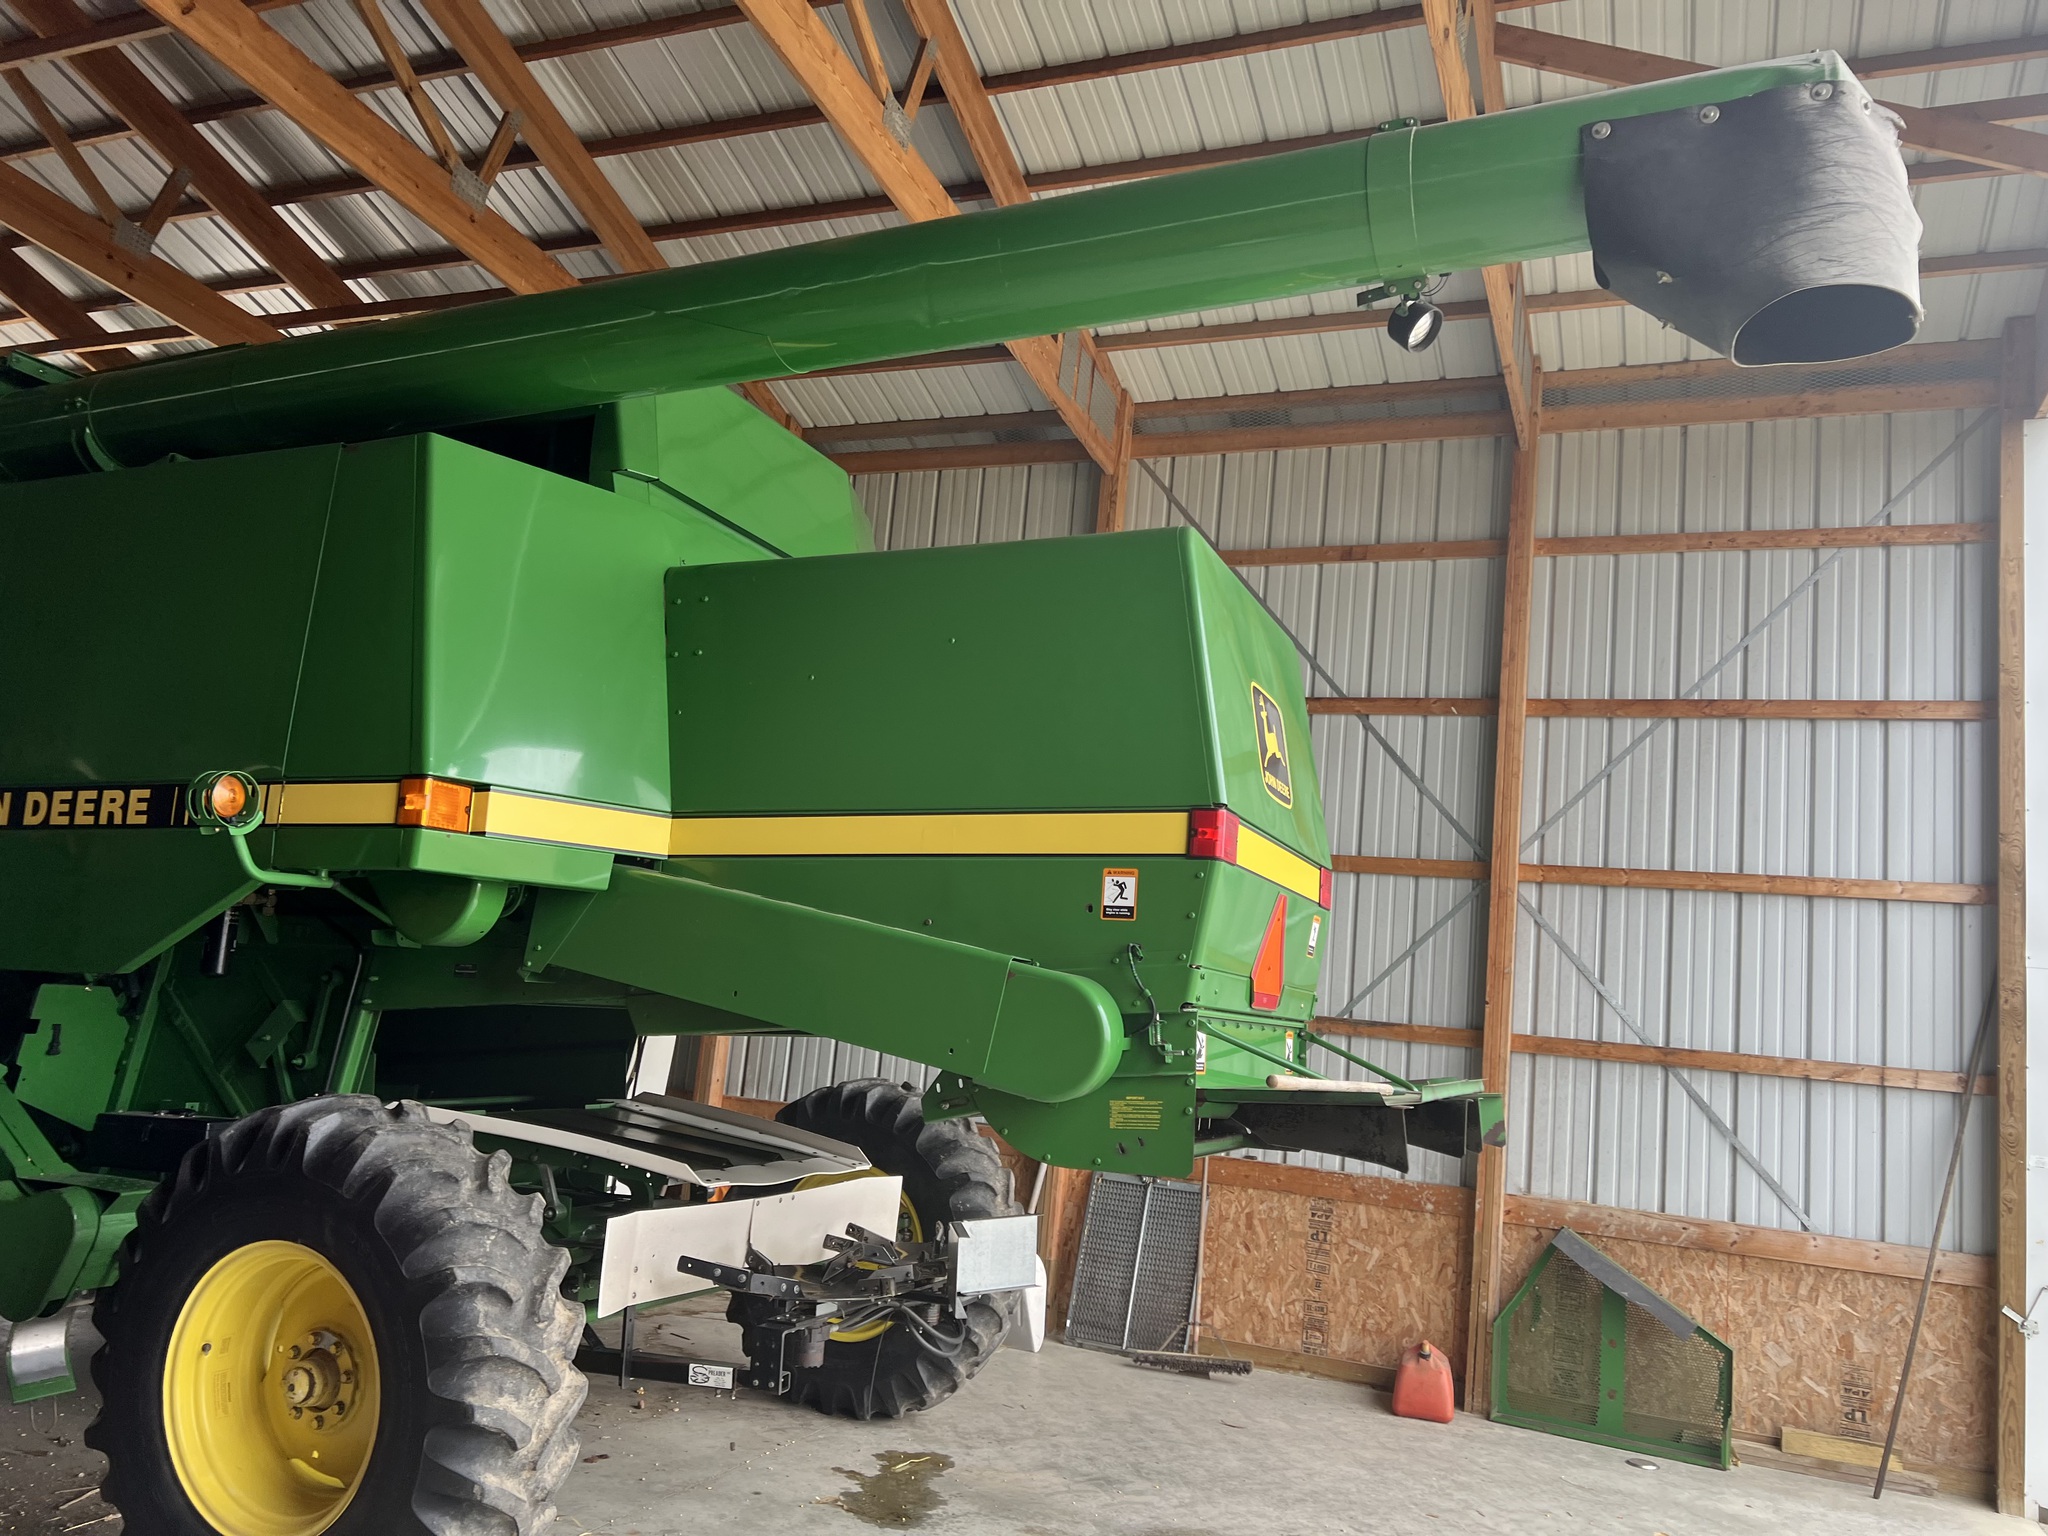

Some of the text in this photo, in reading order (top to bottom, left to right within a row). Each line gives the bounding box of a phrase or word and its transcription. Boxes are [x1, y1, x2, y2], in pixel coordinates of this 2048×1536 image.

[22, 788, 151, 826] DEERE
[1310, 1211, 1331, 1221] APA
[1310, 1230, 1328, 1243] LP
[1844, 1387, 1870, 1397] APA
[1844, 1408, 1867, 1424] LP
